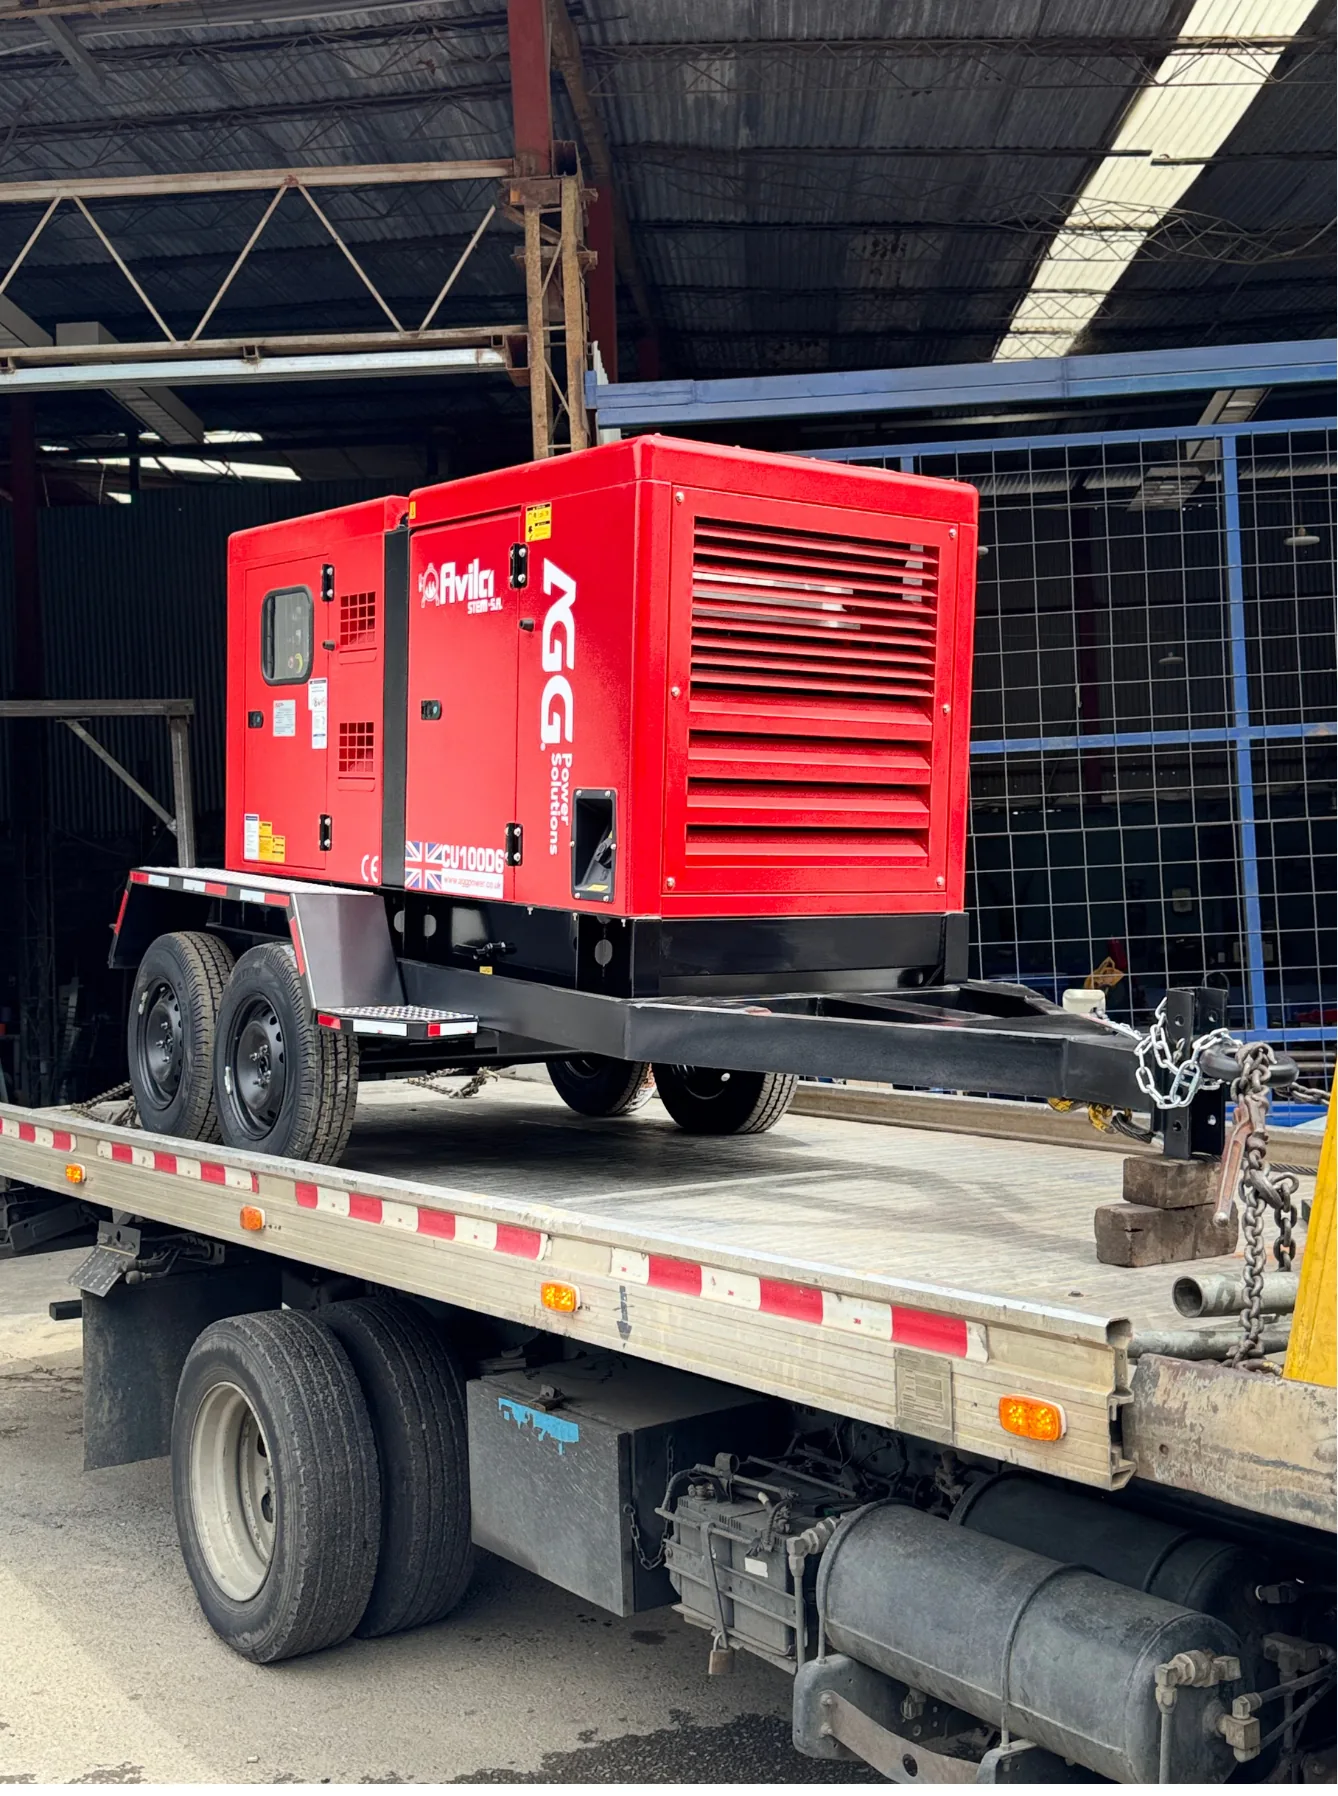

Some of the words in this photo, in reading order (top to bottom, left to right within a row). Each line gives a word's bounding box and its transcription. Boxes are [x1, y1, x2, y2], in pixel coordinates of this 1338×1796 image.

[440, 558, 495, 605] Avila
[541, 558, 577, 744] AGG
[549, 753, 562, 856] Solutions
[560, 753, 573, 827] Power
[442, 844, 504, 874] CU100D6
